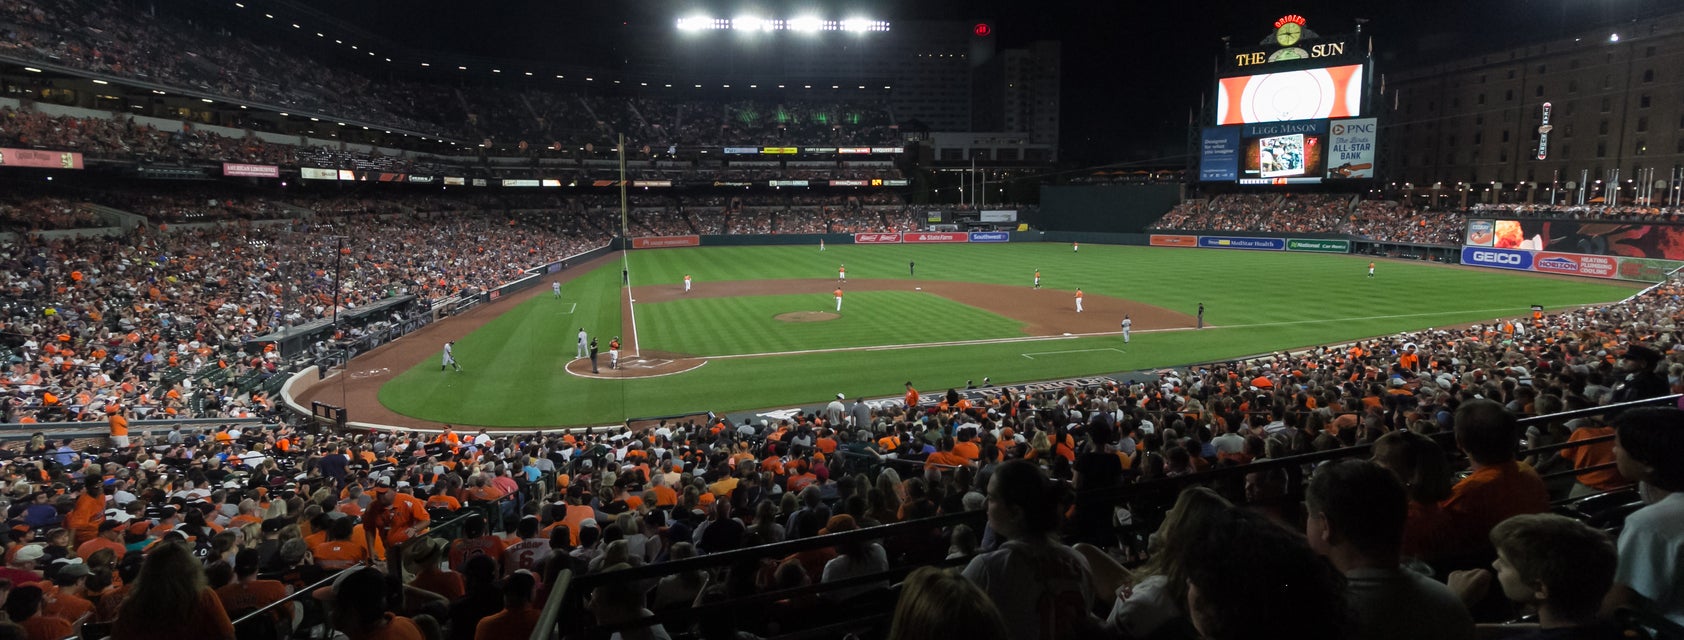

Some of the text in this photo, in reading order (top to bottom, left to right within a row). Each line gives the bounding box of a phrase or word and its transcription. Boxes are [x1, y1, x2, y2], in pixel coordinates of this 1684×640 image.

[1274, 14, 1306, 28] ORIOLES
[1235, 42, 1345, 66] THE SUN
[1251, 124, 1316, 135] LEGG MASON
[1347, 124, 1375, 134] PNC
[1340, 152, 1361, 160] BANK
[973, 233, 1002, 241] Southwest
[1473, 251, 1521, 264] GEICO
[1538, 261, 1578, 270] HORIZON
[519, 550, 535, 570] 6
